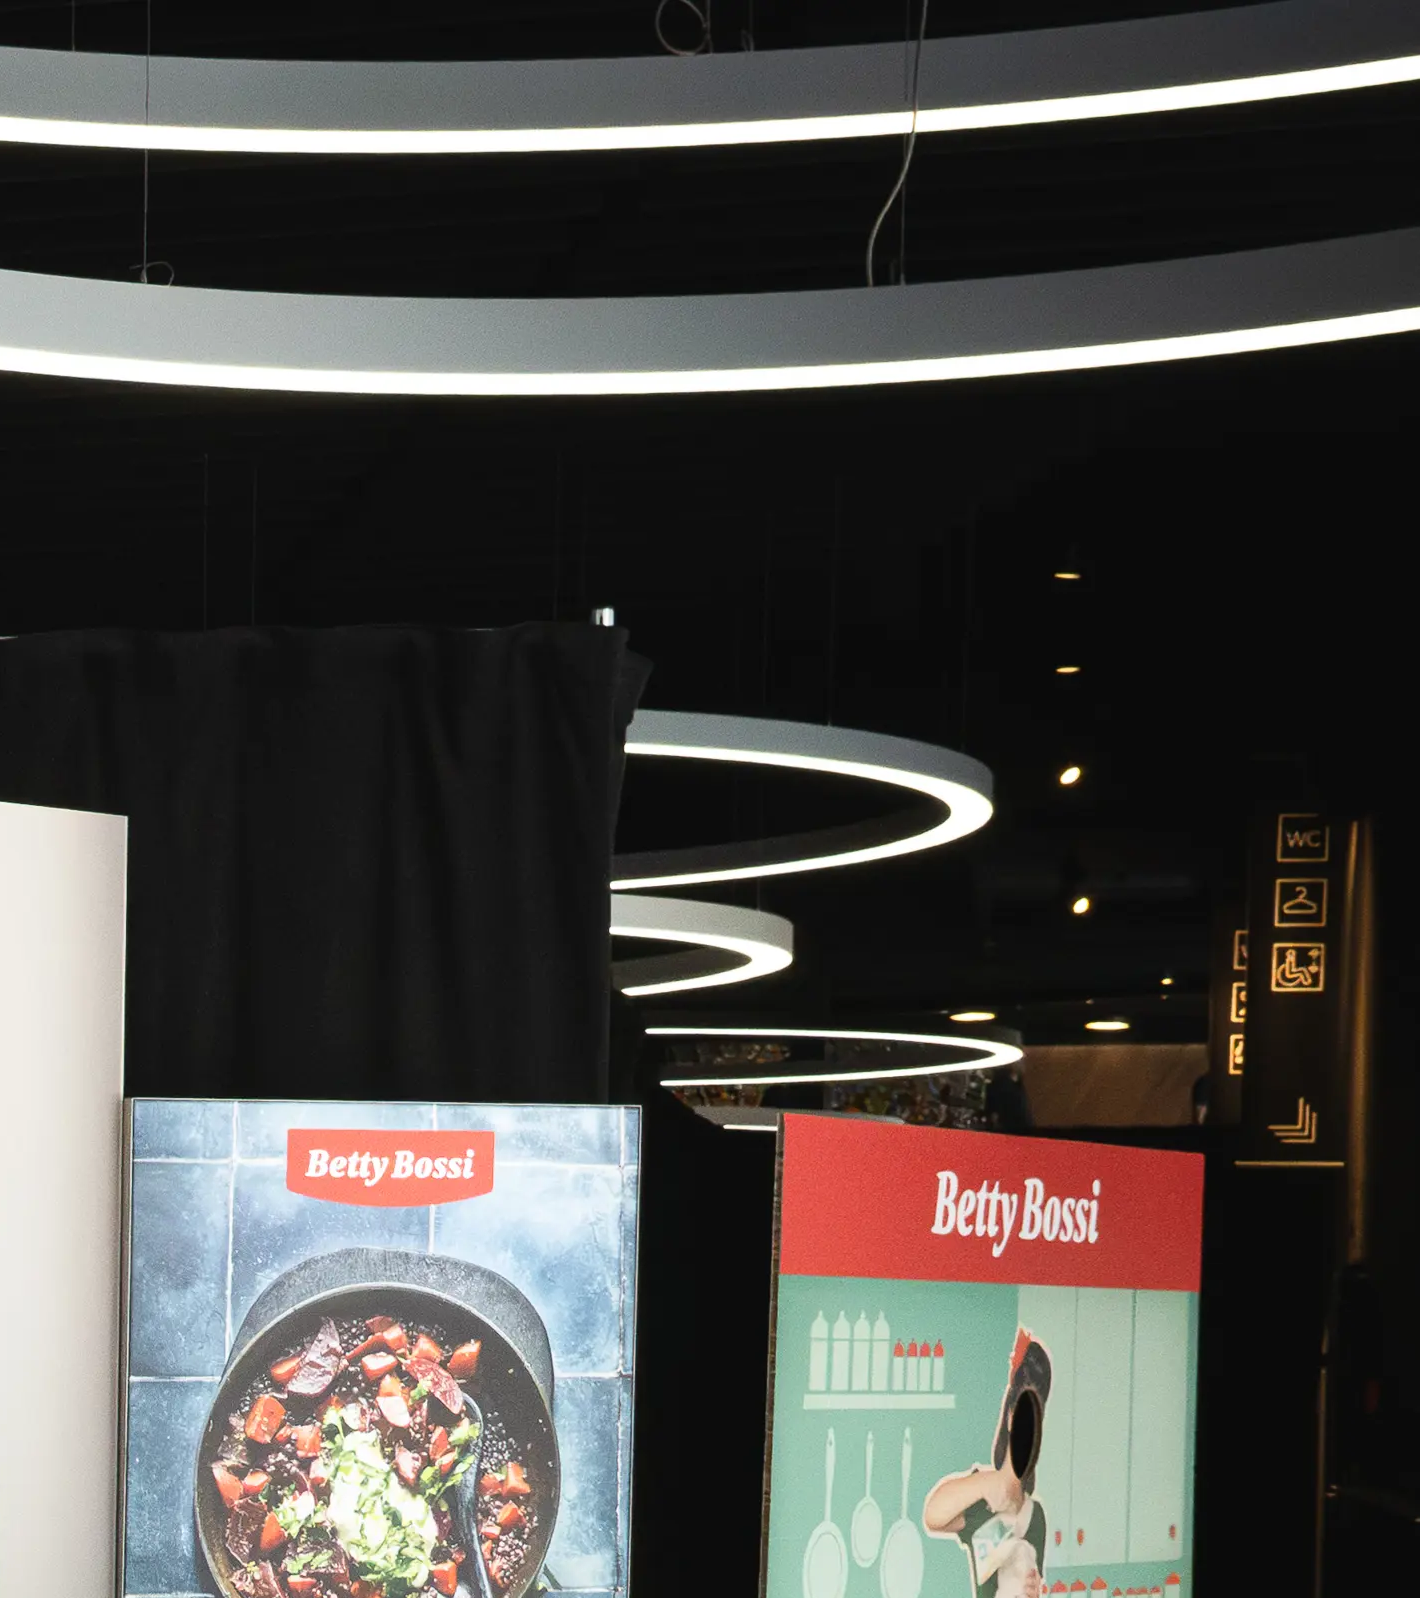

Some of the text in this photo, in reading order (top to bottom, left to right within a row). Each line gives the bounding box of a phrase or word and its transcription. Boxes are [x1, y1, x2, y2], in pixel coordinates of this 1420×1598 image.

[1285, 830, 1322, 848] WC
[304, 1148, 475, 1187] Betty Bossi
[930, 1170, 1101, 1258] Betty Bossi
